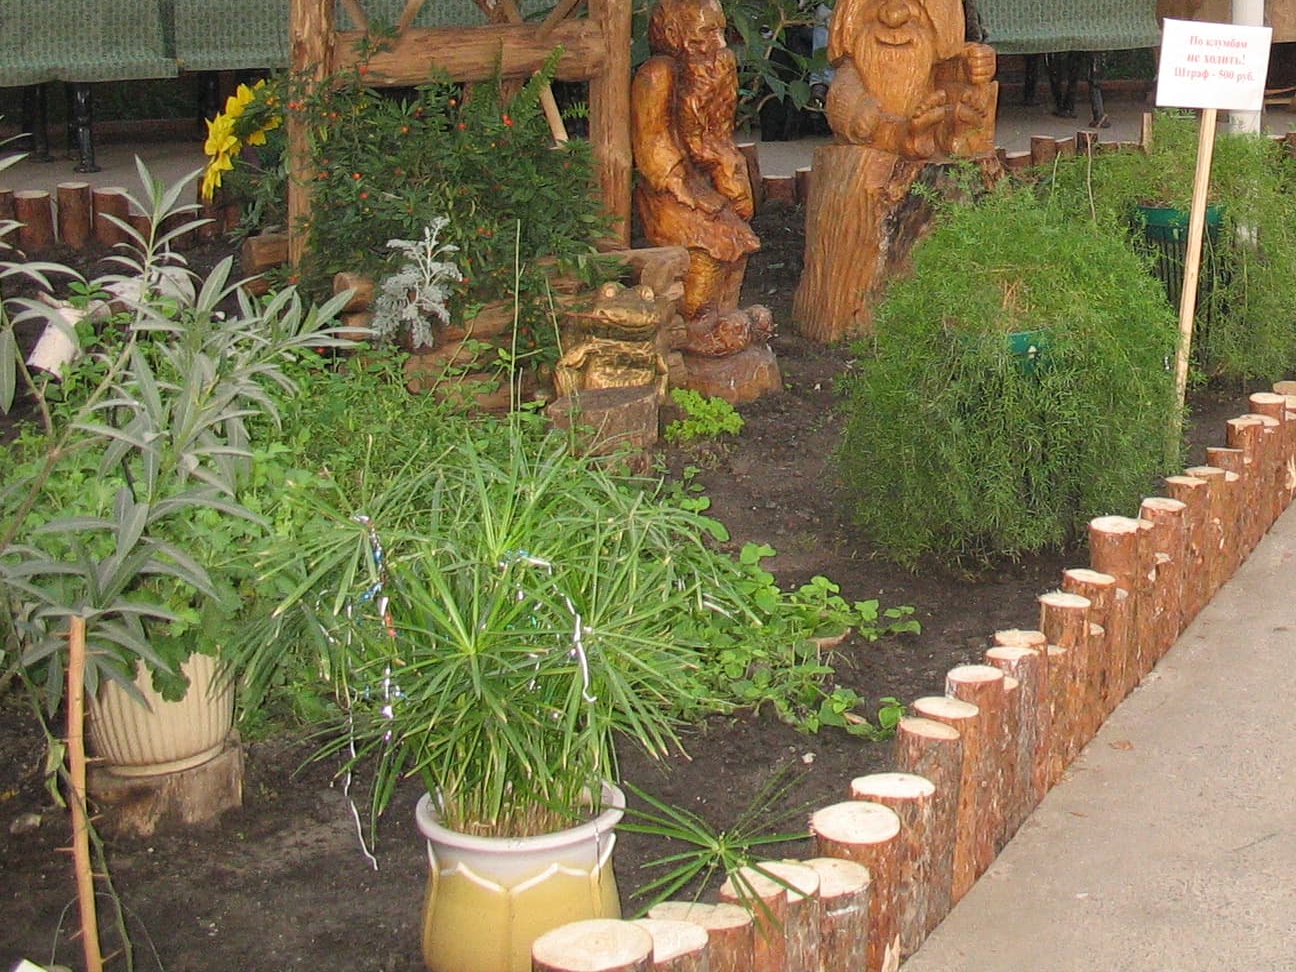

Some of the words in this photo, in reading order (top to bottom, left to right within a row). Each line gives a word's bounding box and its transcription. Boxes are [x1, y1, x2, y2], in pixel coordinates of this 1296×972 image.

[1189, 35, 1203, 46] По
[1206, 37, 1248, 49] клумбам
[1186, 53, 1201, 63] не
[1174, 66, 1210, 81] Штраф
[1218, 69, 1235, 80] 500
[1236, 71, 1256, 83] руб.
